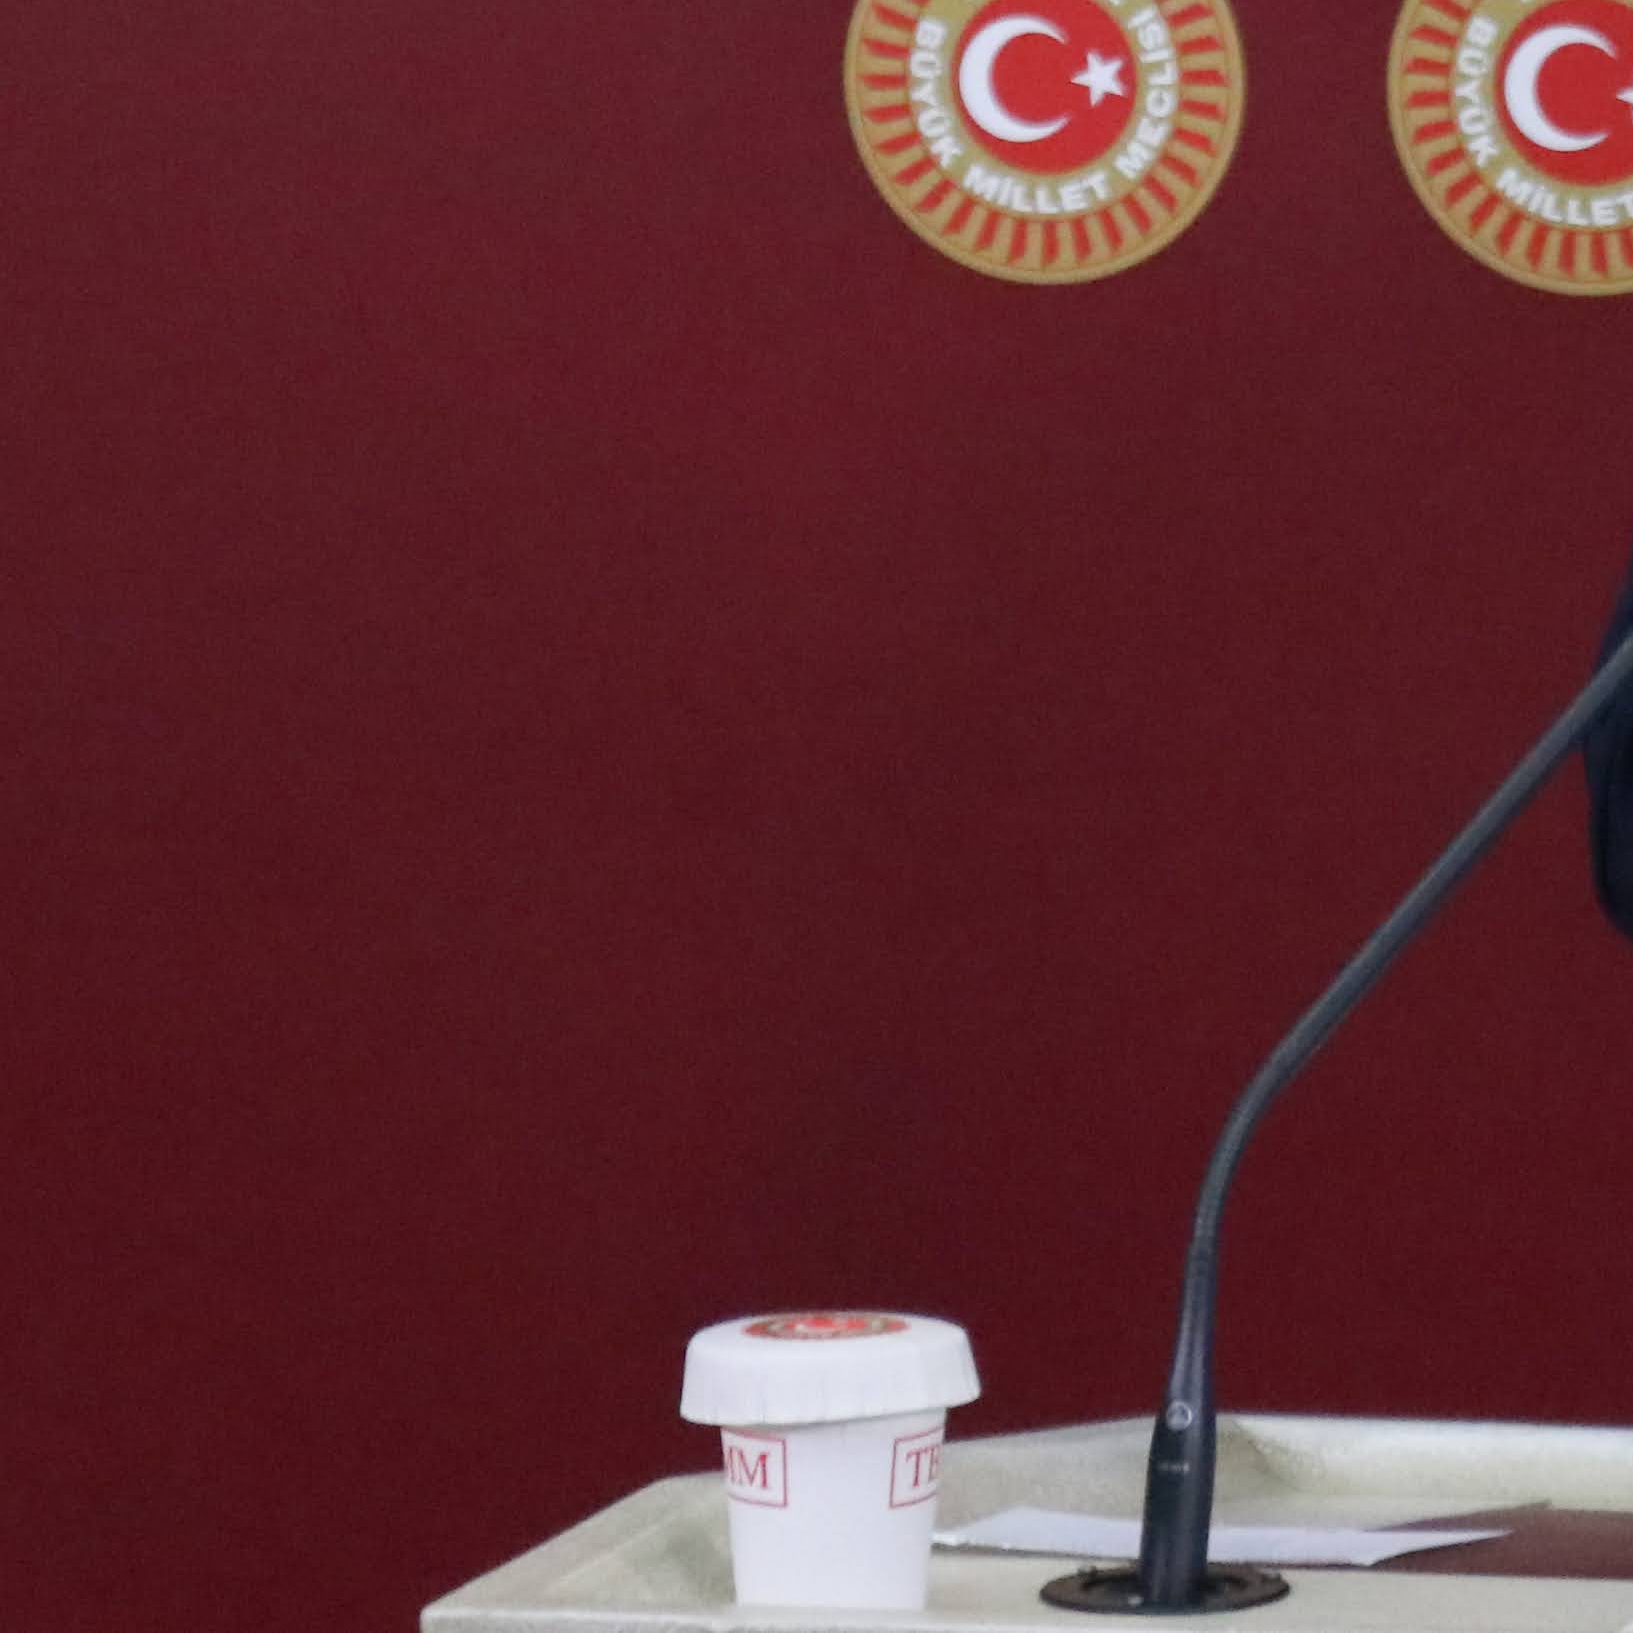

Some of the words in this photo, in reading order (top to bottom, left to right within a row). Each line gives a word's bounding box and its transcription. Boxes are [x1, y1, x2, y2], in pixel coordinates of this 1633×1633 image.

[909, 18, 966, 169] BÜYÜK
[962, 163, 1110, 215] MİLLET
[1454, 15, 1500, 167] BÜYÜK
